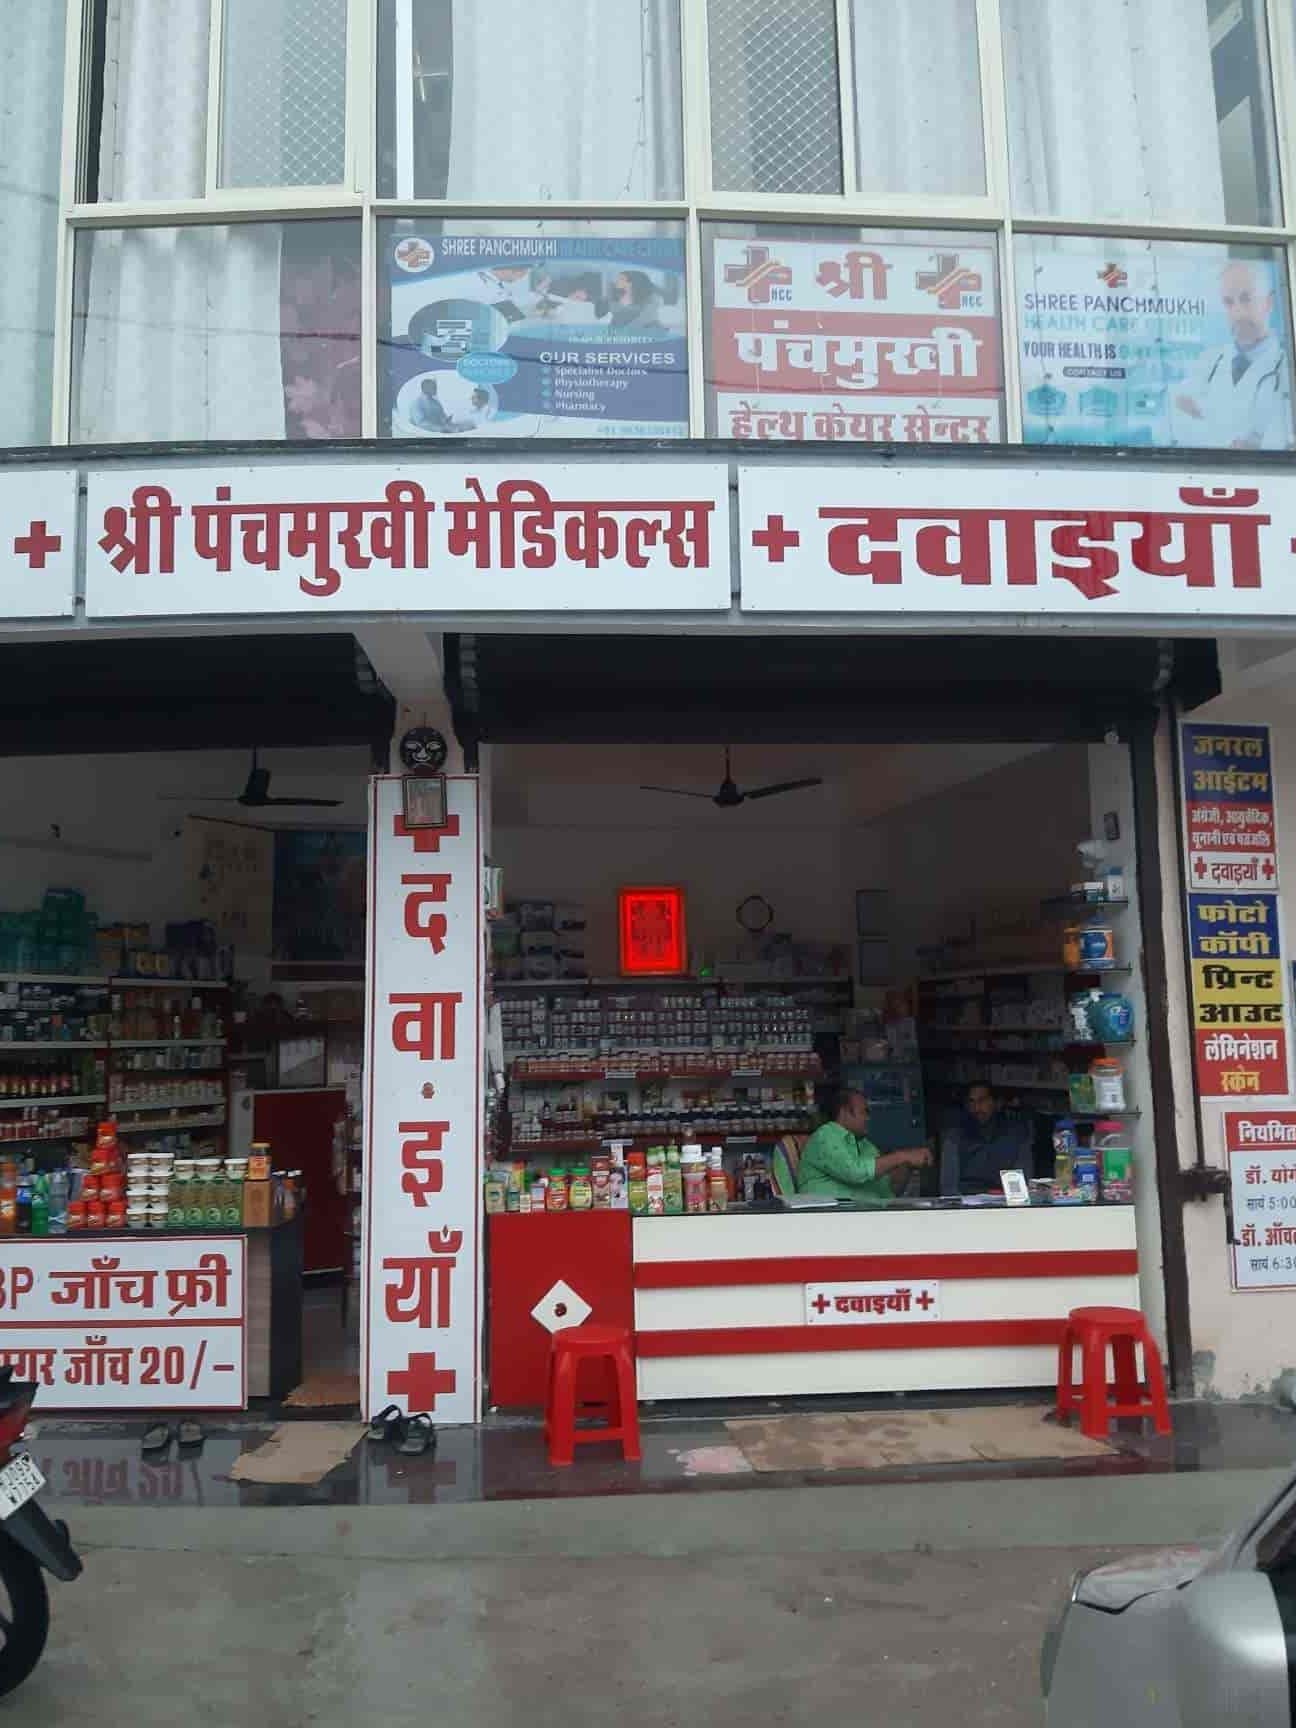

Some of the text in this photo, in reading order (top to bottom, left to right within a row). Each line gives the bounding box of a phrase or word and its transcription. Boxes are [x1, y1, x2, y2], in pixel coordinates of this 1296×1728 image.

[442, 239, 476, 256] SHREE
[479, 239, 557, 257] PANCHMUKHI
[815, 249, 894, 301] श्री
[1024, 293, 1206, 317] SHREE PANCHMUKHI
[539, 351, 676, 364] OUR SERVICES
[733, 320, 983, 390] पंचमुखी
[1024, 341, 1056, 359] YOUR
[1058, 342, 1102, 359] HEALTH
[555, 378, 629, 390] Physiotherapy
[555, 389, 595, 401] Nursing
[555, 400, 607, 412] Pharmacy
[97, 478, 716, 597] श्री पंचमुखी मेडिकल्स
[818, 486, 1271, 600] दवाइयाँ
[1192, 736, 1265, 758] जनरल
[1192, 764, 1269, 795] आईटम
[1197, 900, 1269, 924] फोटो
[1198, 931, 1272, 954] कॉपी
[1200, 1003, 1284, 1023] आउट
[48, 1255, 158, 1309] जाँच
[165, 1253, 232, 1317] फ्री
[833, 1288, 912, 1314] दवाइयाँ
[63, 1335, 133, 1386] जाँच
[139, 1340, 235, 1390] 20/-
